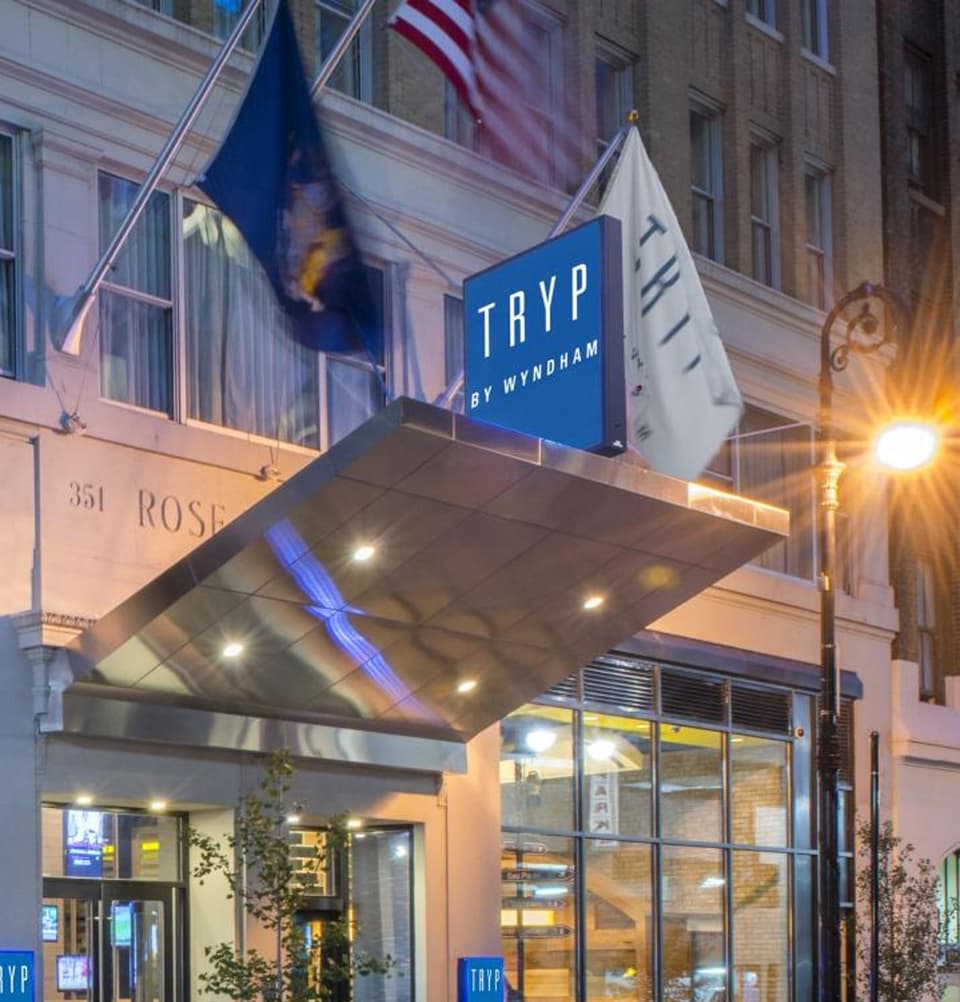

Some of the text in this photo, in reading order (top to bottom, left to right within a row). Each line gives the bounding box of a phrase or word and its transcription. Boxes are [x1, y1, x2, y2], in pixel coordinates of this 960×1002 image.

[478, 263, 588, 358] TRYP
[470, 339, 599, 409] BY WYNDHAM
[69, 482, 104, 512] 351
[471, 968, 501, 992] TRYP
